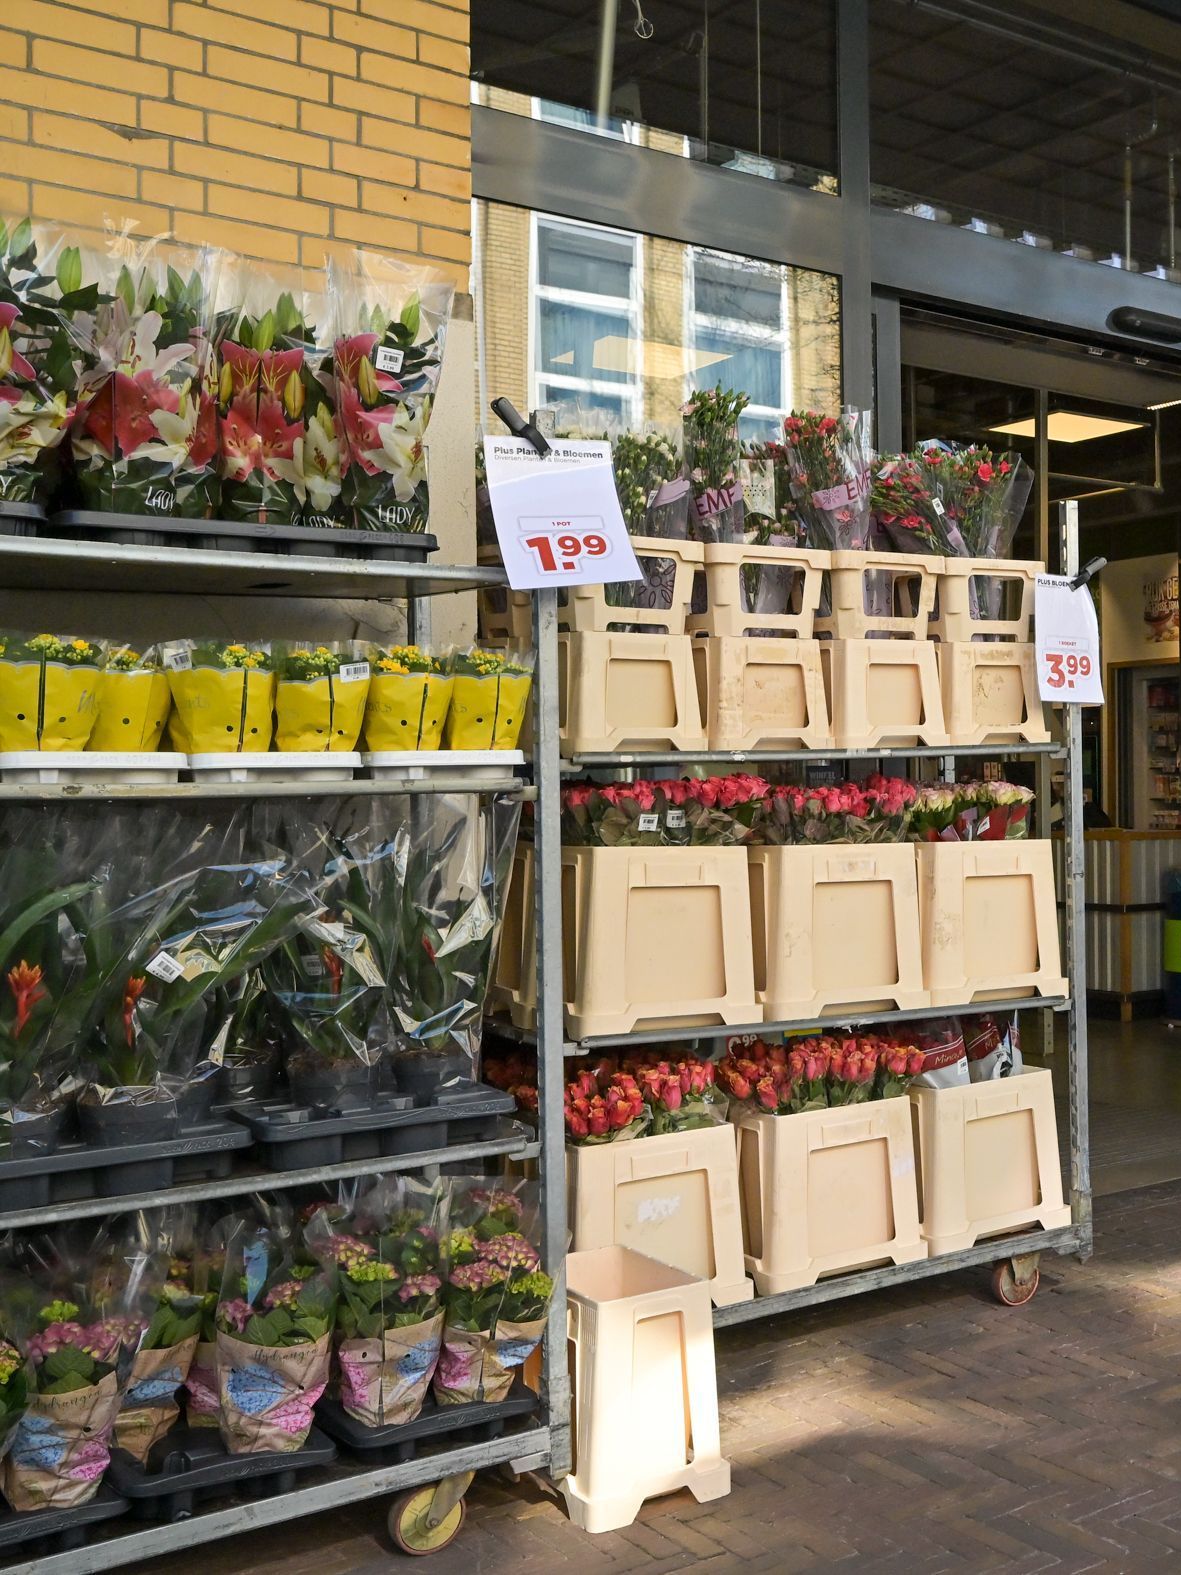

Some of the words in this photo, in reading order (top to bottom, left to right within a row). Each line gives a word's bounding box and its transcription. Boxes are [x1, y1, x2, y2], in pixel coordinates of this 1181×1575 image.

[494, 446, 514, 455] Plus
[516, 447, 552, 457] Plan
[554, 449, 561, 457] &
[563, 450, 604, 459] Bloemen
[145, 486, 177, 512] LADY
[378, 504, 415, 524] LADY
[526, 534, 607, 572] 1.99
[1037, 578, 1051, 586] PLUS
[1045, 653, 1091, 689] 3.99
